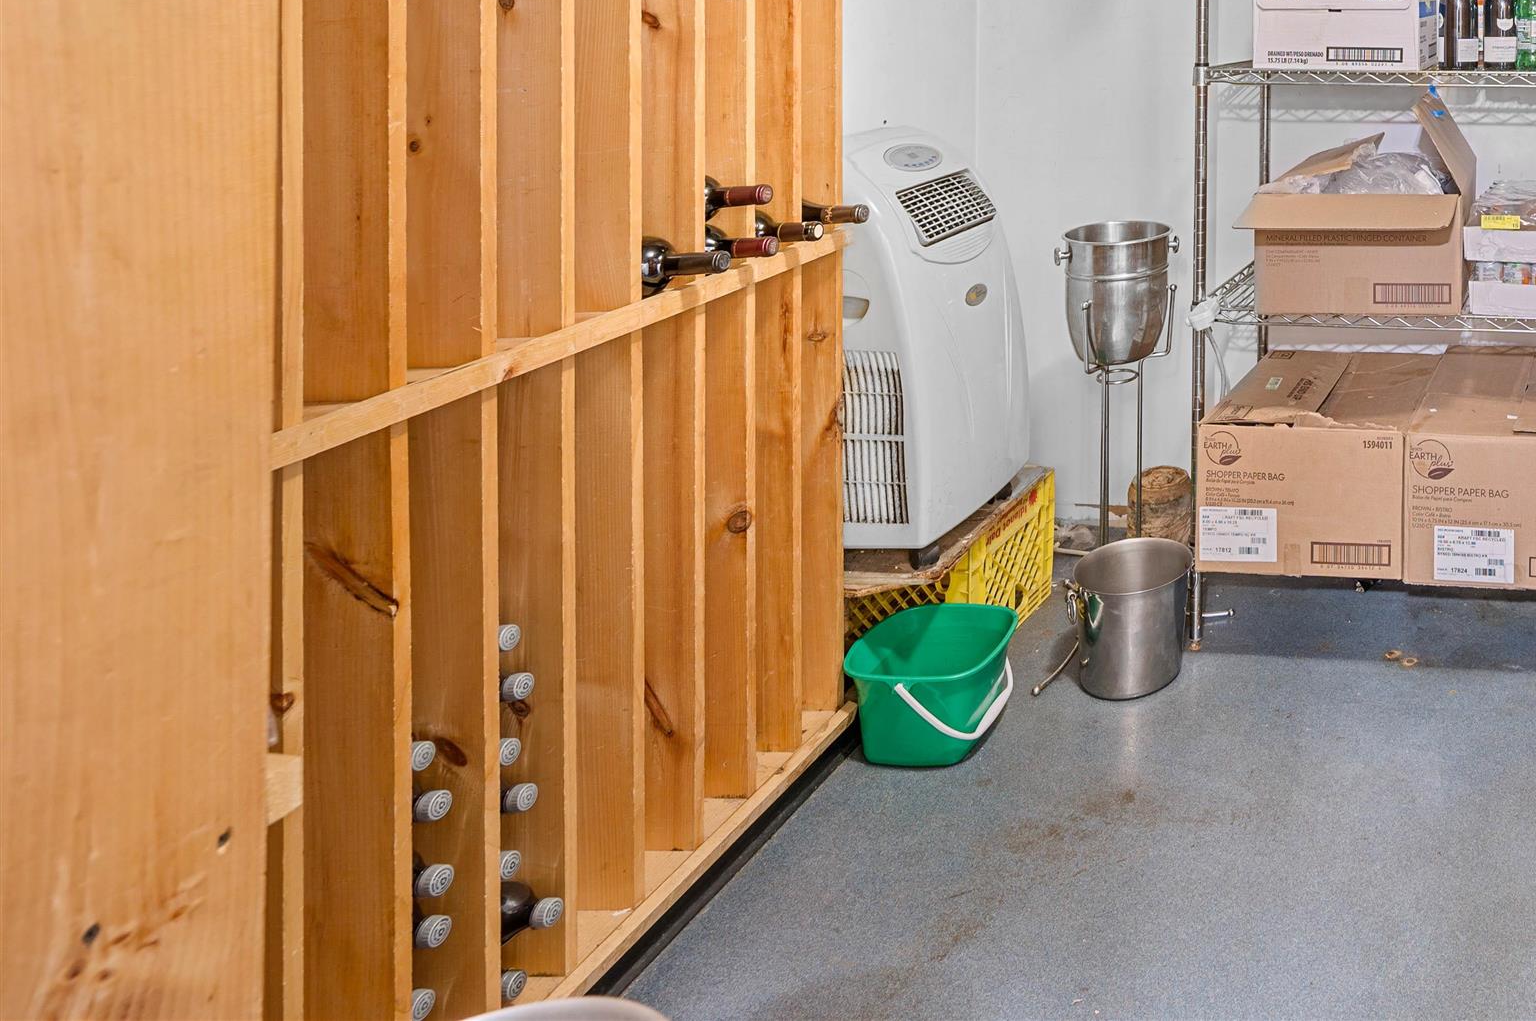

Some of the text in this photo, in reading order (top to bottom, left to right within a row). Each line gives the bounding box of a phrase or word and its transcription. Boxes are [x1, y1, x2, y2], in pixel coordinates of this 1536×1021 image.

[1363, 440, 1393, 450] 1594011
[1409, 451, 1437, 460] EARTH
[1206, 470, 1285, 482] SHOPPER PAPER BAG
[1412, 485, 1509, 499] SHOPPER PAPER BAG
